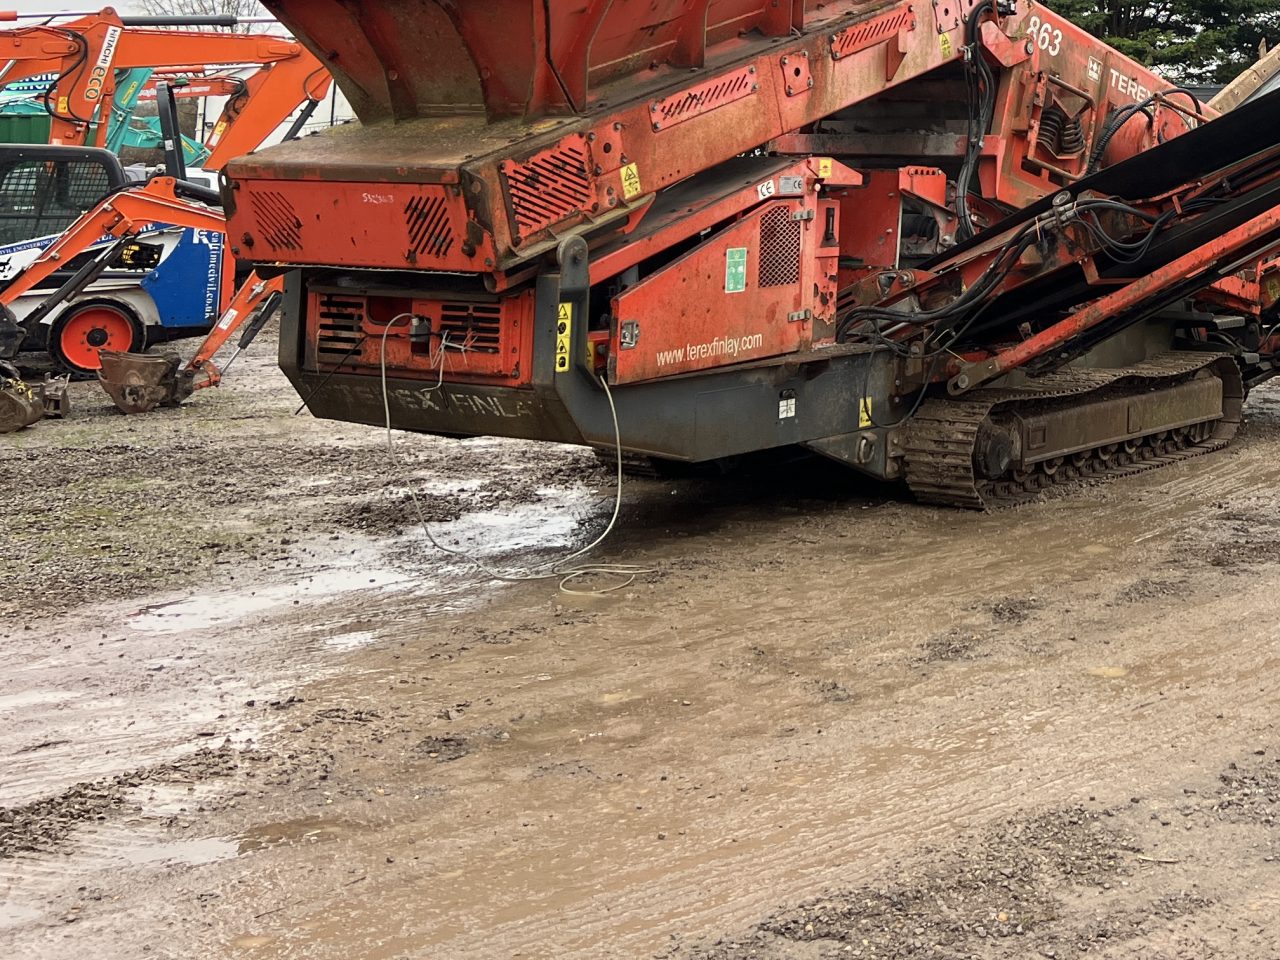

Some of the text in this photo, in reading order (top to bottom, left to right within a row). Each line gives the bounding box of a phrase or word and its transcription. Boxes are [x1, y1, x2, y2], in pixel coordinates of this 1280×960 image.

[100, 29, 118, 65] HITACHI
[1026, 15, 1063, 57] 863
[204, 232, 221, 319] ealtimecivil.co.uk
[656, 334, 763, 367] www.terexfinlay.com
[448, 393, 543, 418] FINLA
